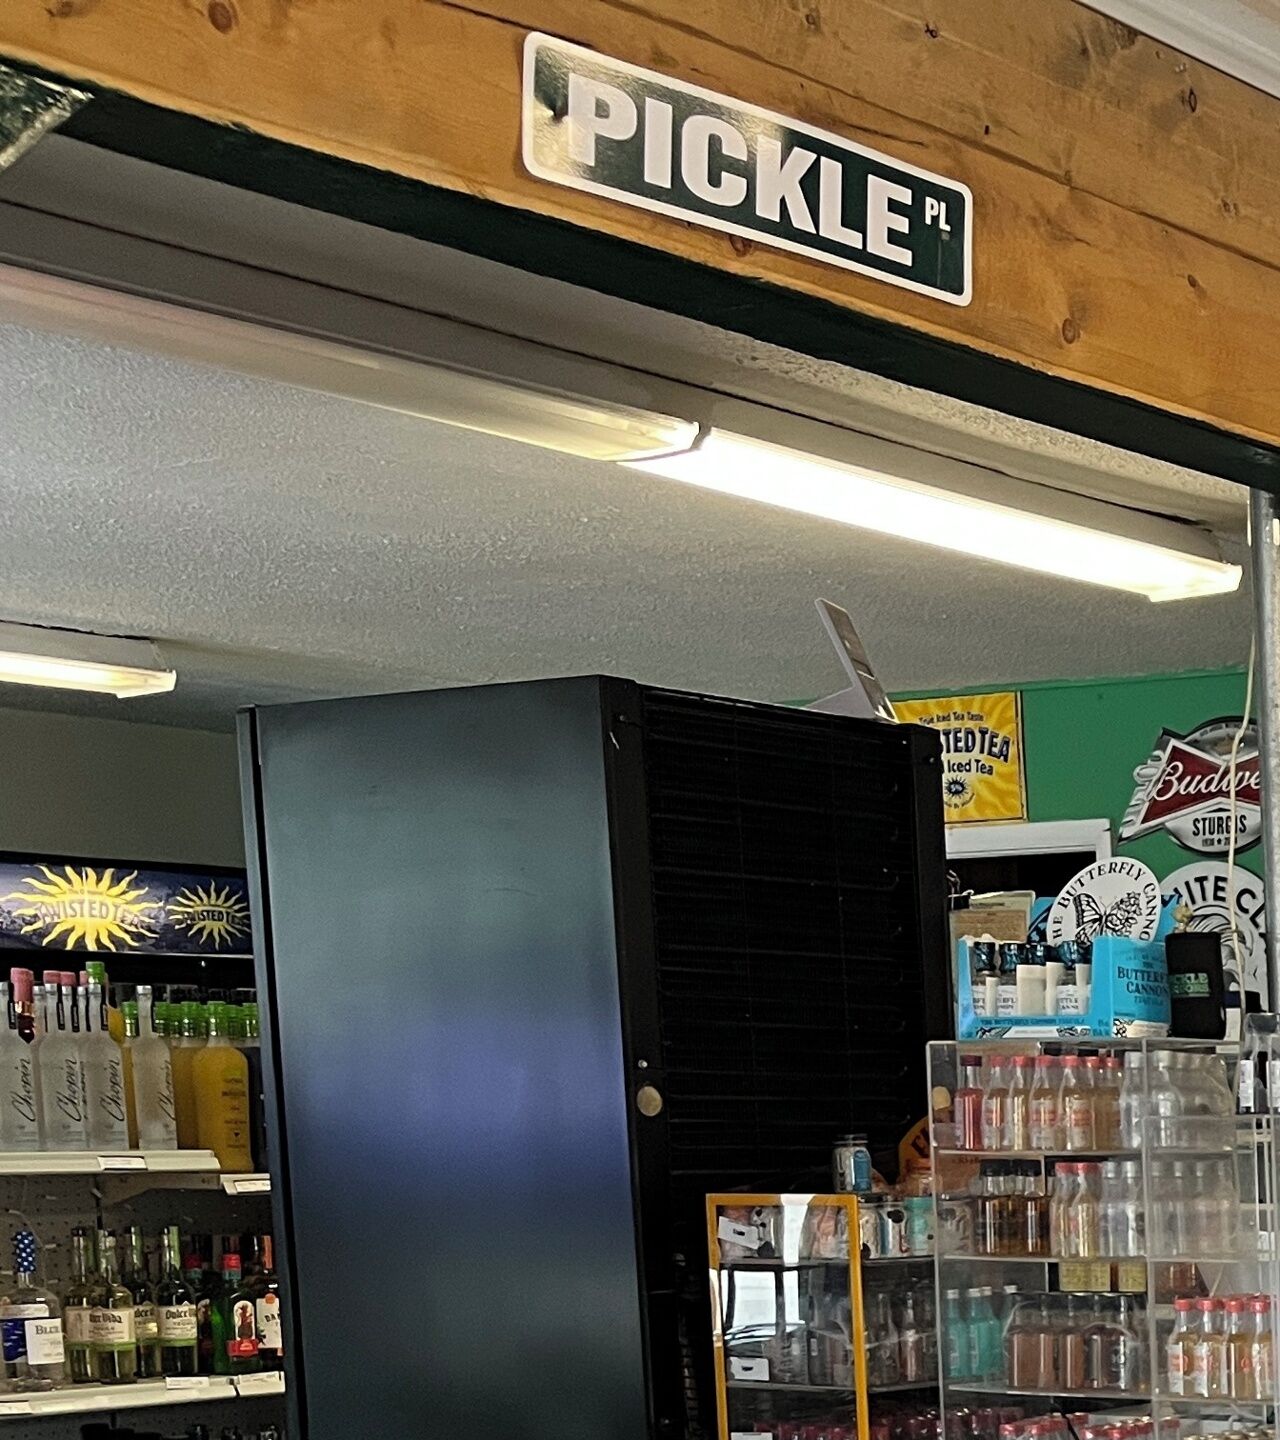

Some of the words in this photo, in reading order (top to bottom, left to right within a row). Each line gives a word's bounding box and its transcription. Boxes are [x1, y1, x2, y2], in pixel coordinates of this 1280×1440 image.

[567, 72, 912, 266] PICKLE
[924, 196, 951, 231] PL
[948, 758, 971, 773] Iced
[974, 759, 993, 775] Tea
[979, 727, 1011, 763] TEA
[1060, 862, 1146, 910] BUTTERFLY
[11, 1057, 35, 1123] Chopin
[58, 1056, 82, 1122] Chopin
[100, 1057, 125, 1122] Chopin
